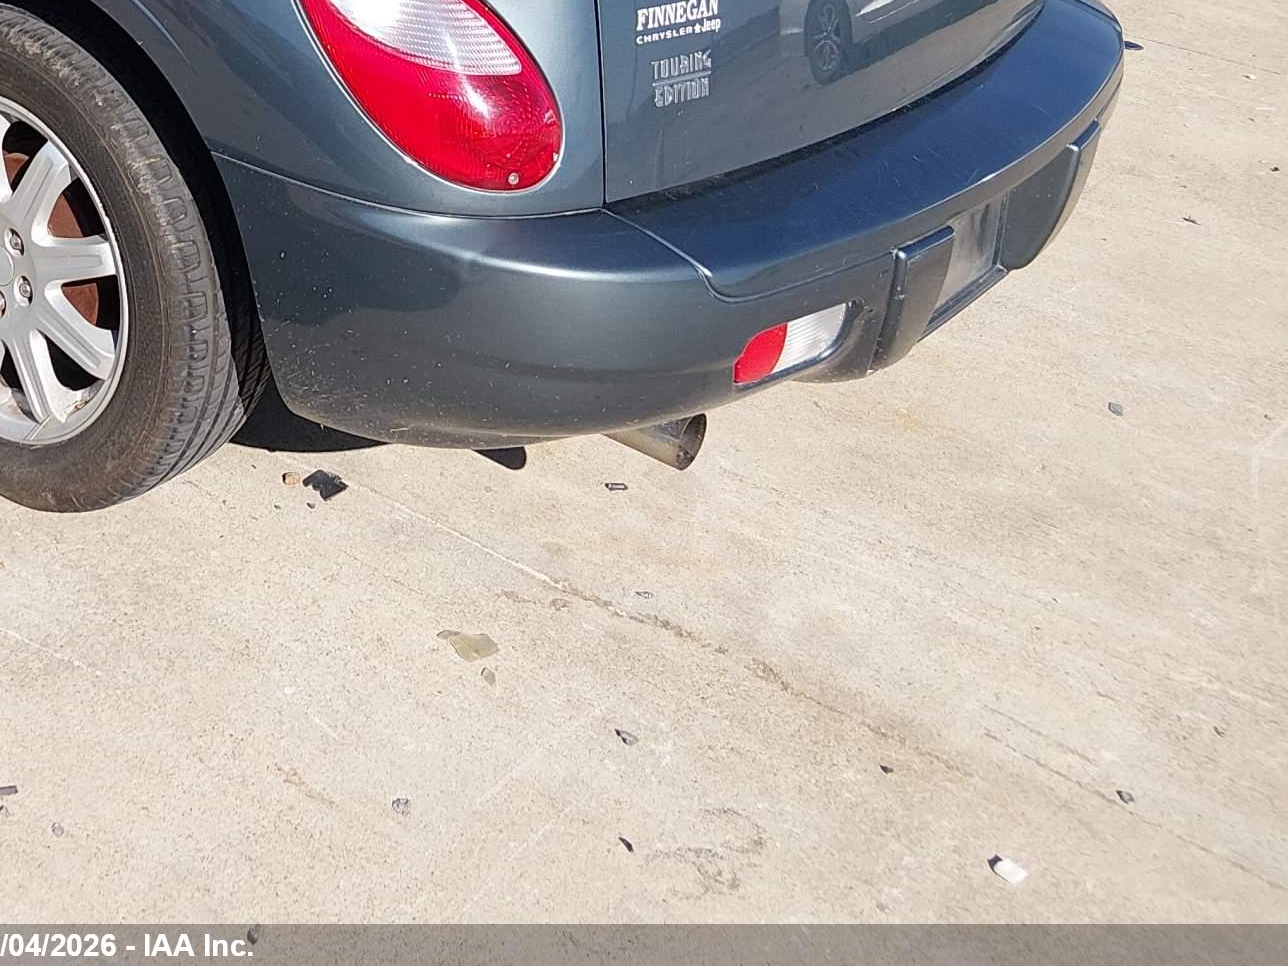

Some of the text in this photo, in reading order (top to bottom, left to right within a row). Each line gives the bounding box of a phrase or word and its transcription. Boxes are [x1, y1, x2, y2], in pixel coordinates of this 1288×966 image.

[636, 18, 721, 44] CHRYSLER Jeep
[651, 49, 712, 80] TOURING
[655, 77, 710, 107] EDITION
